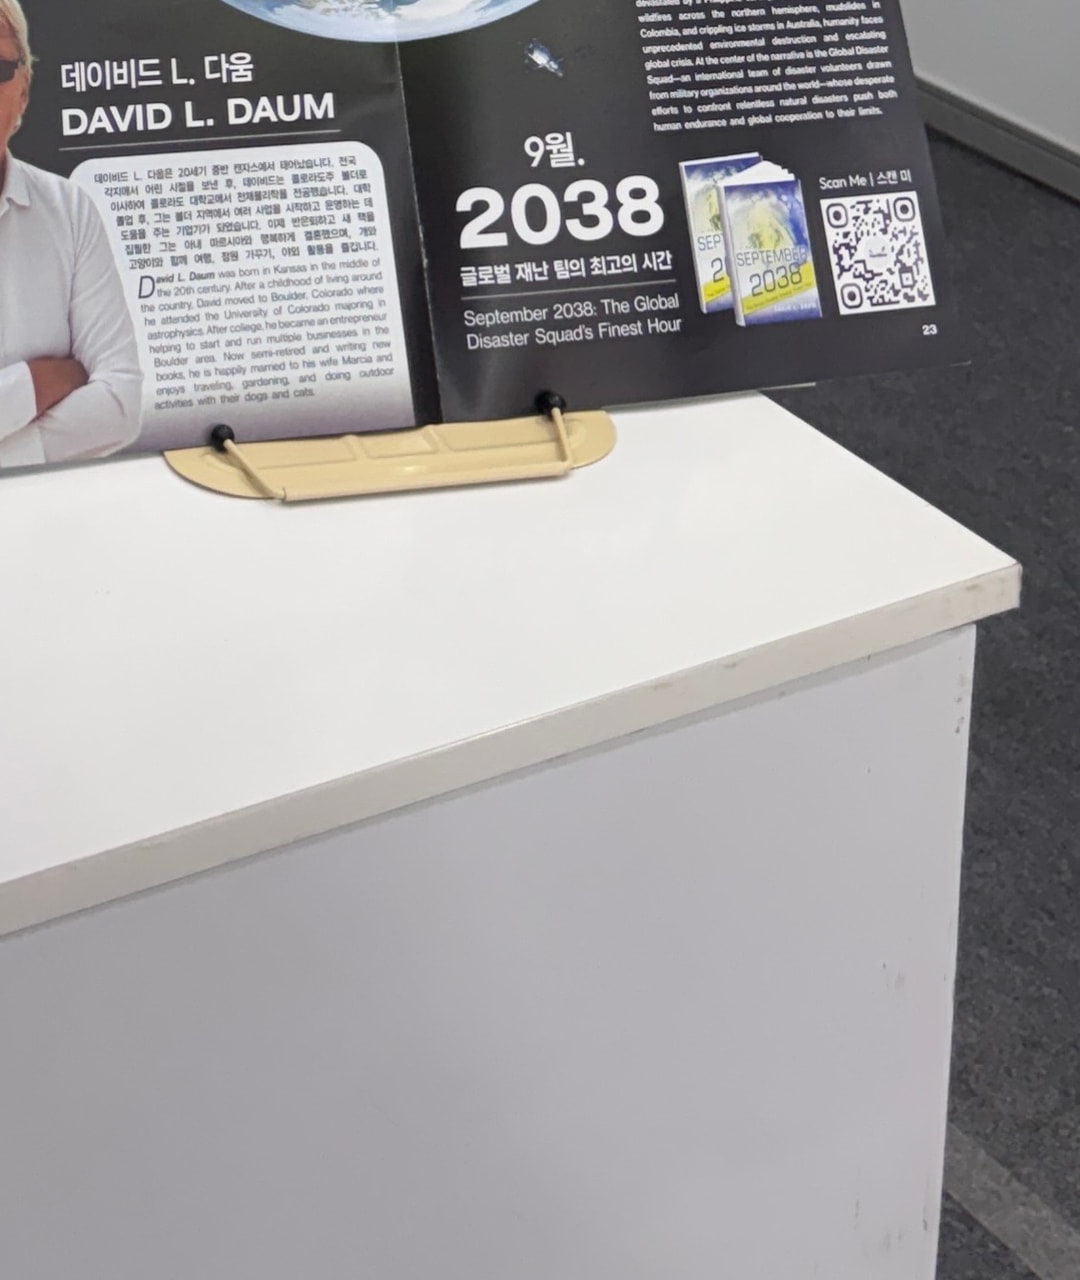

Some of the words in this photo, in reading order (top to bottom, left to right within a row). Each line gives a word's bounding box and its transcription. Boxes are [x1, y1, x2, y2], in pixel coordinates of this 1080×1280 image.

[60, 58, 163, 94] 데이비드
[171, 59, 196, 86] L.
[203, 50, 254, 84] 다움
[60, 100, 172, 137] DAVID
[185, 98, 215, 128] L.
[227, 91, 335, 126] DAUM
[652, 121, 682, 132] human
[685, 119, 727, 130] endurance
[729, 117, 746, 127] and
[747, 114, 773, 127] global
[774, 111, 824, 124] cooperation
[825, 110, 835, 120] to
[837, 108, 856, 118] their
[522, 130, 586, 169] 9월.
[94, 171, 129, 184] 데이비드
[178, 166, 206, 178] 20세기
[818, 175, 847, 190] Scan
[849, 174, 868, 187] Me
[876, 170, 899, 186] 스캔
[900, 168, 913, 183] 미
[455, 173, 665, 250] 2038
[189, 271, 216, 283] Daum
[218, 271, 236, 280] was
[239, 267, 260, 277] born
[262, 266, 271, 276] in
[273, 264, 307, 275] Kansas
[311, 262, 319, 271] in
[321, 260, 336, 271] the
[339, 258, 369, 270] middle
[372, 257, 382, 268] of
[460, 263, 512, 287] 글로벌
[514, 260, 550, 283] 재난
[553, 257, 586, 281] 팀의
[589, 252, 638, 276] 최고의
[641, 249, 673, 271] 시간
[736, 246, 809, 268] SEPTEMBER
[750, 264, 804, 298] 2038
[463, 305, 549, 328] September
[552, 300, 598, 321] 2038:
[600, 299, 630, 315] The
[634, 293, 680, 313] Global
[467, 332, 530, 351] Disaster
[534, 324, 594, 347] Squad's
[598, 320, 643, 340] Finest
[647, 317, 682, 335] Hour
[921, 323, 937, 336] 23
